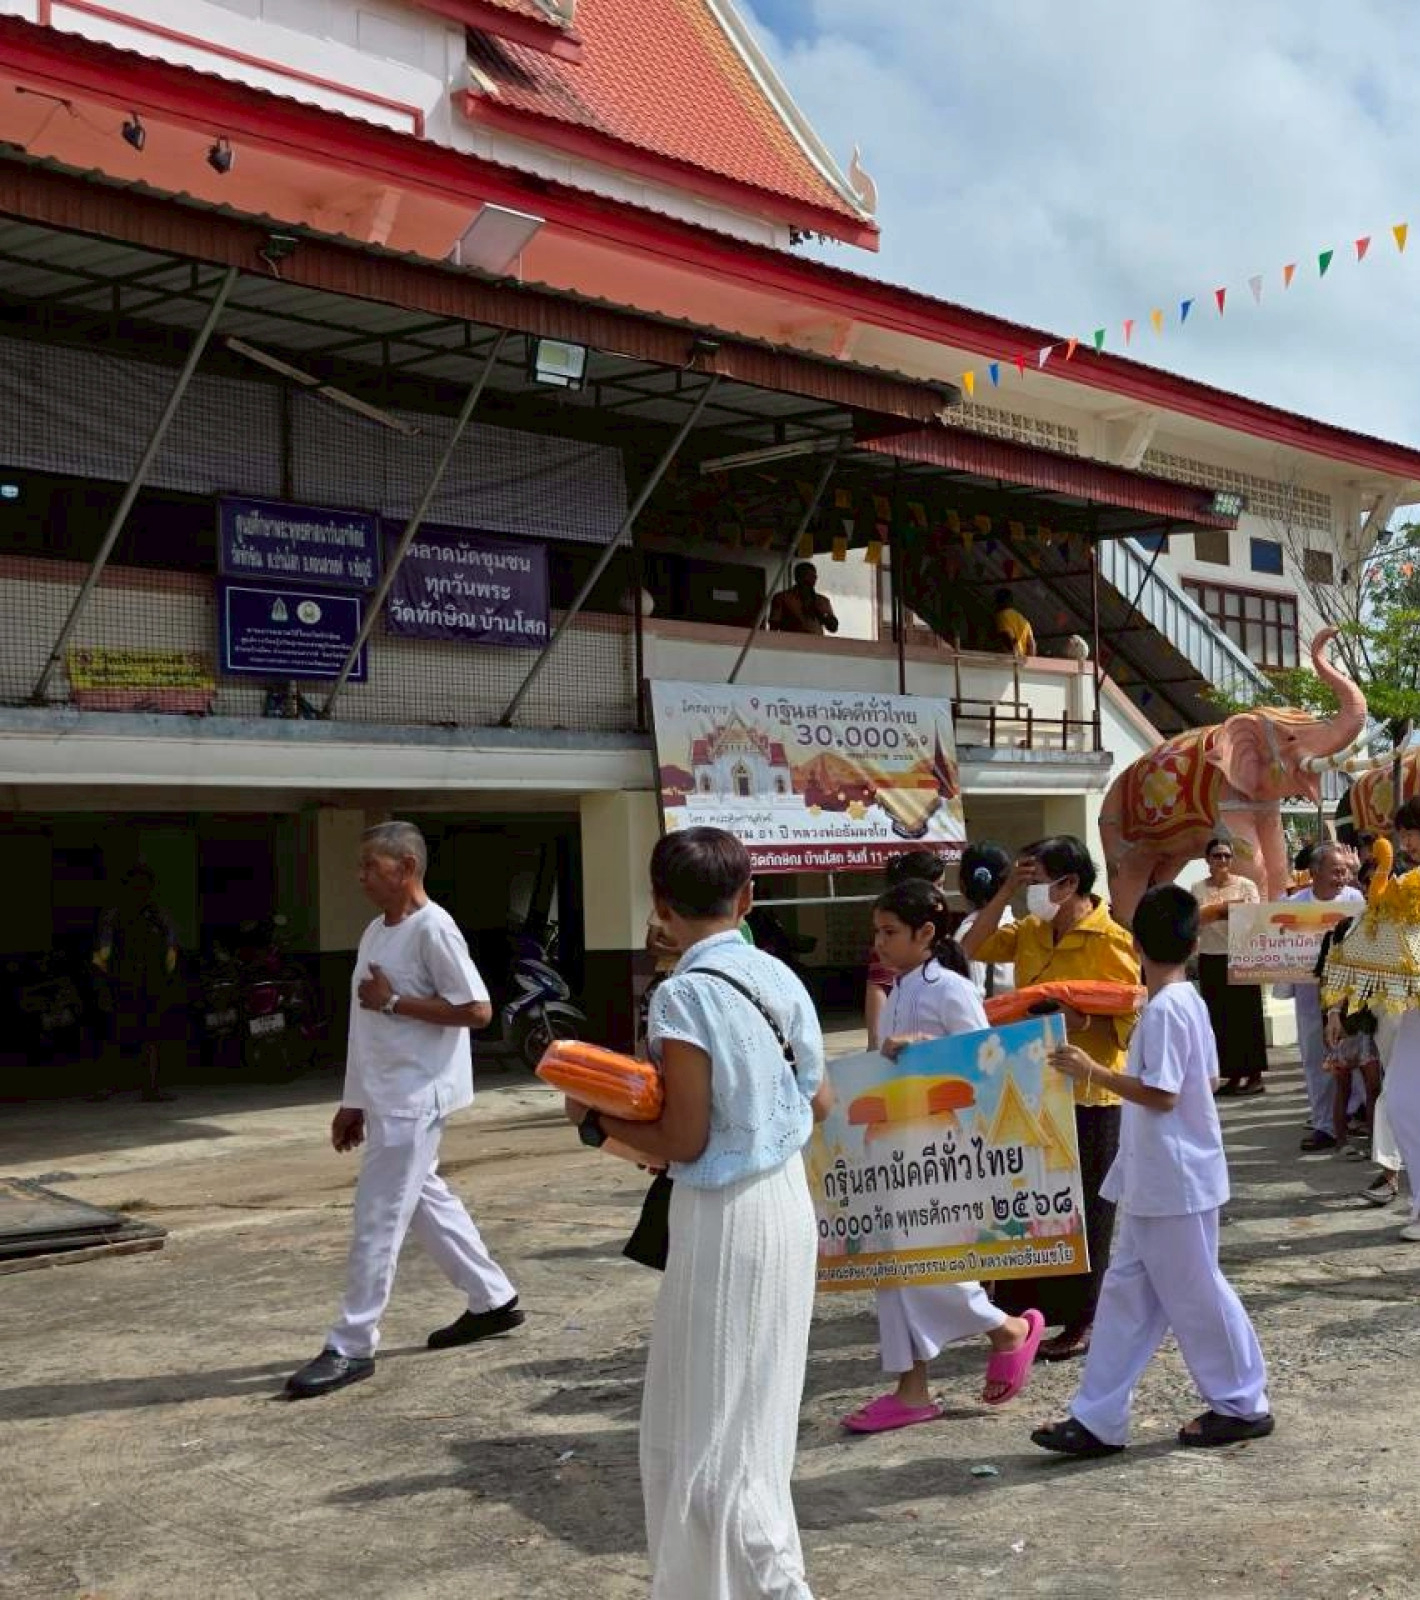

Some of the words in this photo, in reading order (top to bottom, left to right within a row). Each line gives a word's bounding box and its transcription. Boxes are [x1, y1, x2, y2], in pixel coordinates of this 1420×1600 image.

[424, 573, 511, 601] ทุกวันพระ
[390, 599, 476, 630] วัดทักษิณ
[479, 607, 547, 636] บ้านโสก
[765, 697, 918, 726] กฐินสามัคคีทั่วไทย
[824, 1132, 1024, 1208] กฐินสามัคคีทั่วไทย
[896, 1199, 984, 1238] พุทธศักราช
[990, 1187, 1074, 1221] ๒๕๖๘
